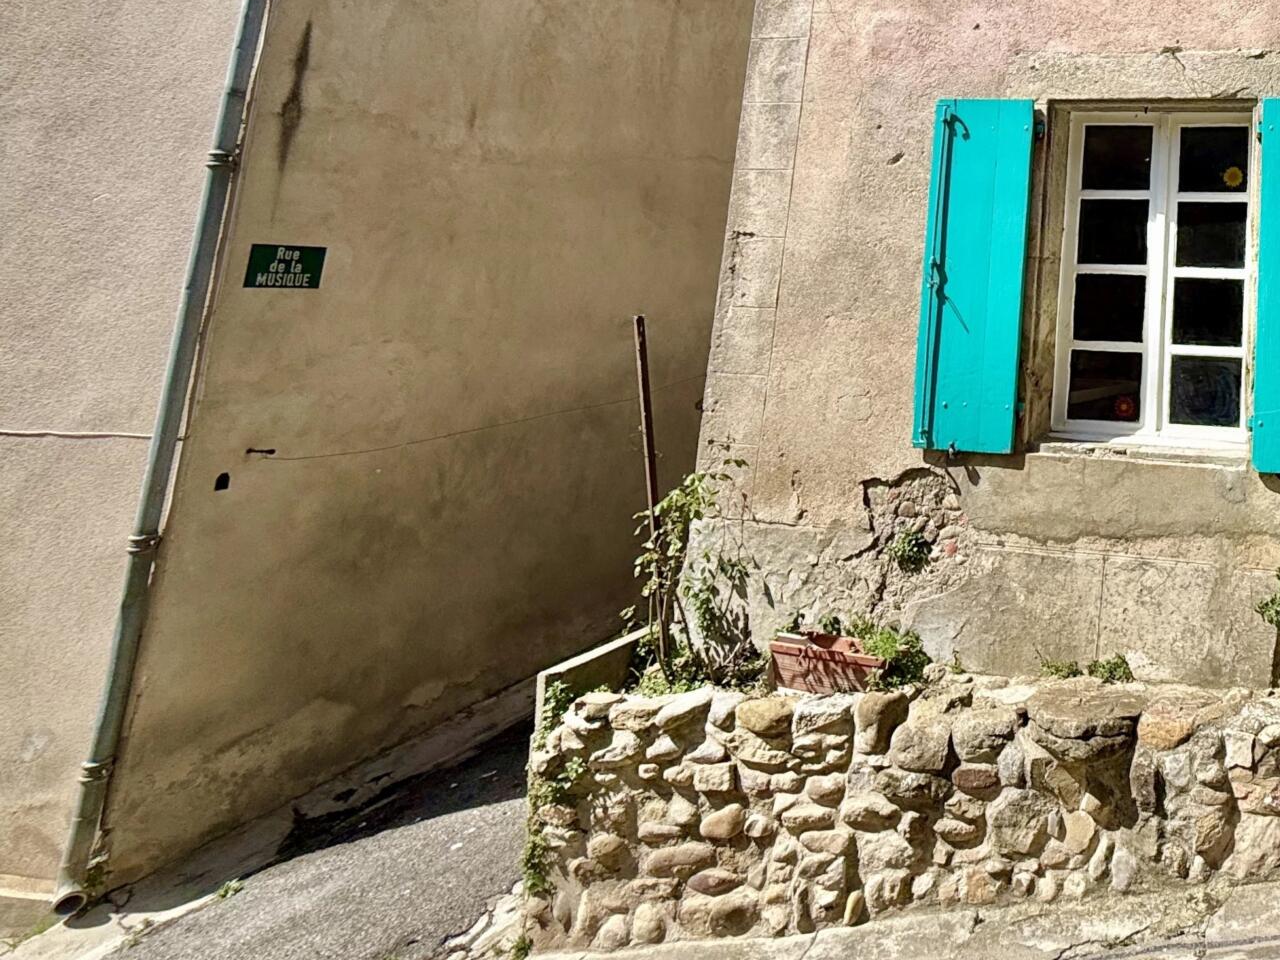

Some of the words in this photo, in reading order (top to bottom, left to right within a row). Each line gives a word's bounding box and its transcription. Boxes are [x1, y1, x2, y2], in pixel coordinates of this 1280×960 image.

[277, 247, 300, 260] Rue
[269, 260, 285, 272] de
[290, 260, 302, 273] la
[256, 273, 311, 286] MUSIQUE
